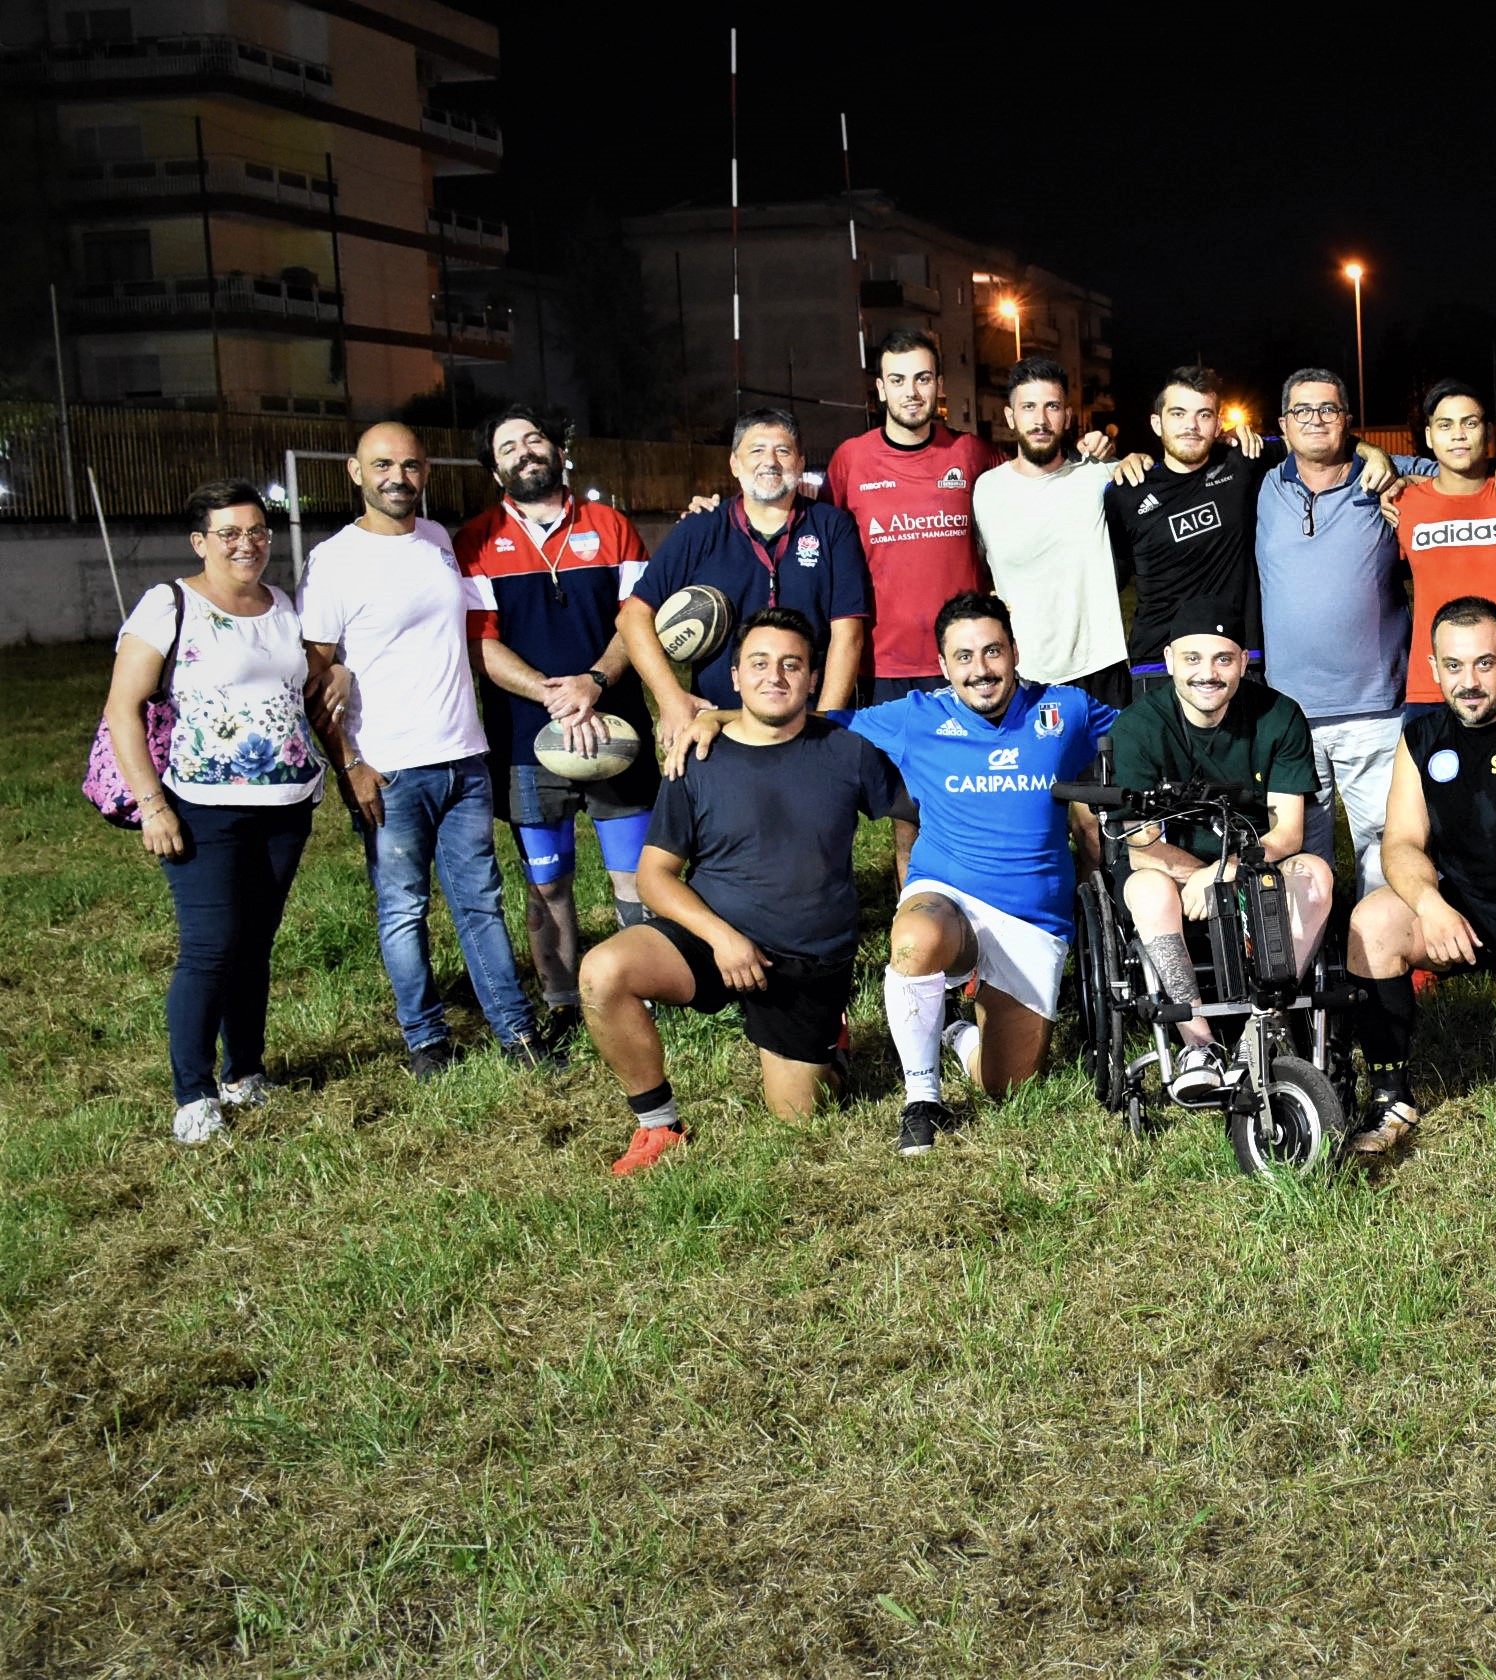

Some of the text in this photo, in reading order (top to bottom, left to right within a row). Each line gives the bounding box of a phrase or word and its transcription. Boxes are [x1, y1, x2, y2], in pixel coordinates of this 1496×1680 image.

[888, 510, 968, 532] Aberdeen
[1179, 509, 1214, 535] AIG
[870, 528, 967, 544] GLOBAL ASSET MANAGEMENT
[945, 772, 1058, 793] CARIPARMA
